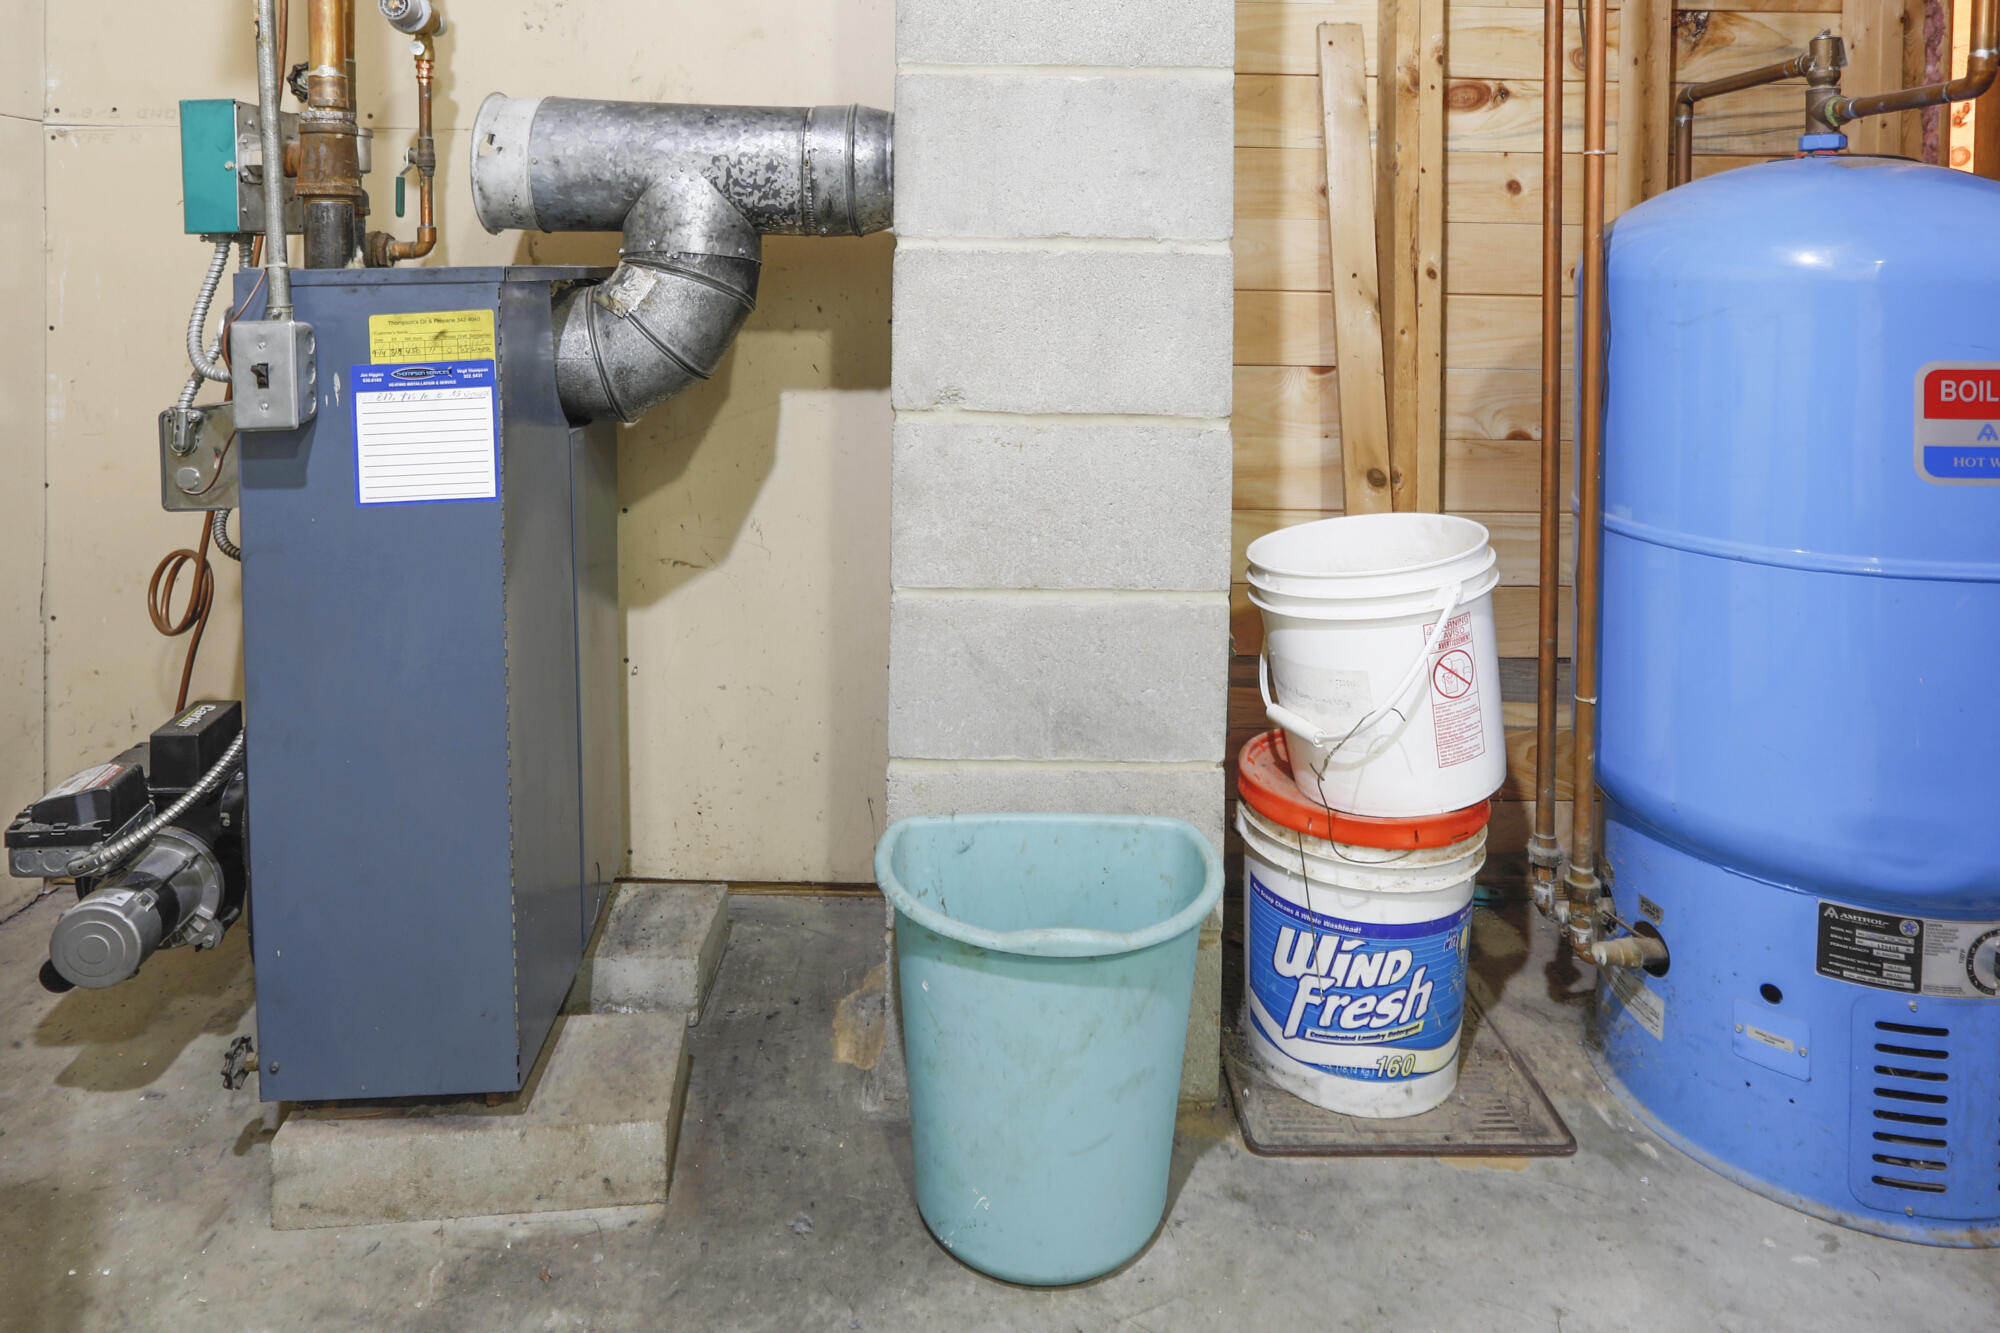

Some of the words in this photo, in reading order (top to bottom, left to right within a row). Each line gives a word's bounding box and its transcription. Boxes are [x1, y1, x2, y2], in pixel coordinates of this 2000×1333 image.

[1953, 457, 1986, 467] HOT
[1438, 633, 1471, 650] AVERTISSEMENT
[1443, 626, 1466, 640] AVISO
[178, 704, 217, 728] Carlin
[1260, 888, 1275, 904] Scoop
[1275, 900, 1294, 915] Cleans
[1300, 912, 1322, 926] Whole
[1323, 919, 1363, 935] Washload!
[1840, 913, 1890, 926] AMTROL
[1282, 964, 1436, 1040] Fresh
[1310, 1032, 1357, 1042] Concentrated
[1357, 1032, 1387, 1042] Laundry
[1387, 1023, 1420, 1038] Detergent
[1376, 1053, 1416, 1079] 160
